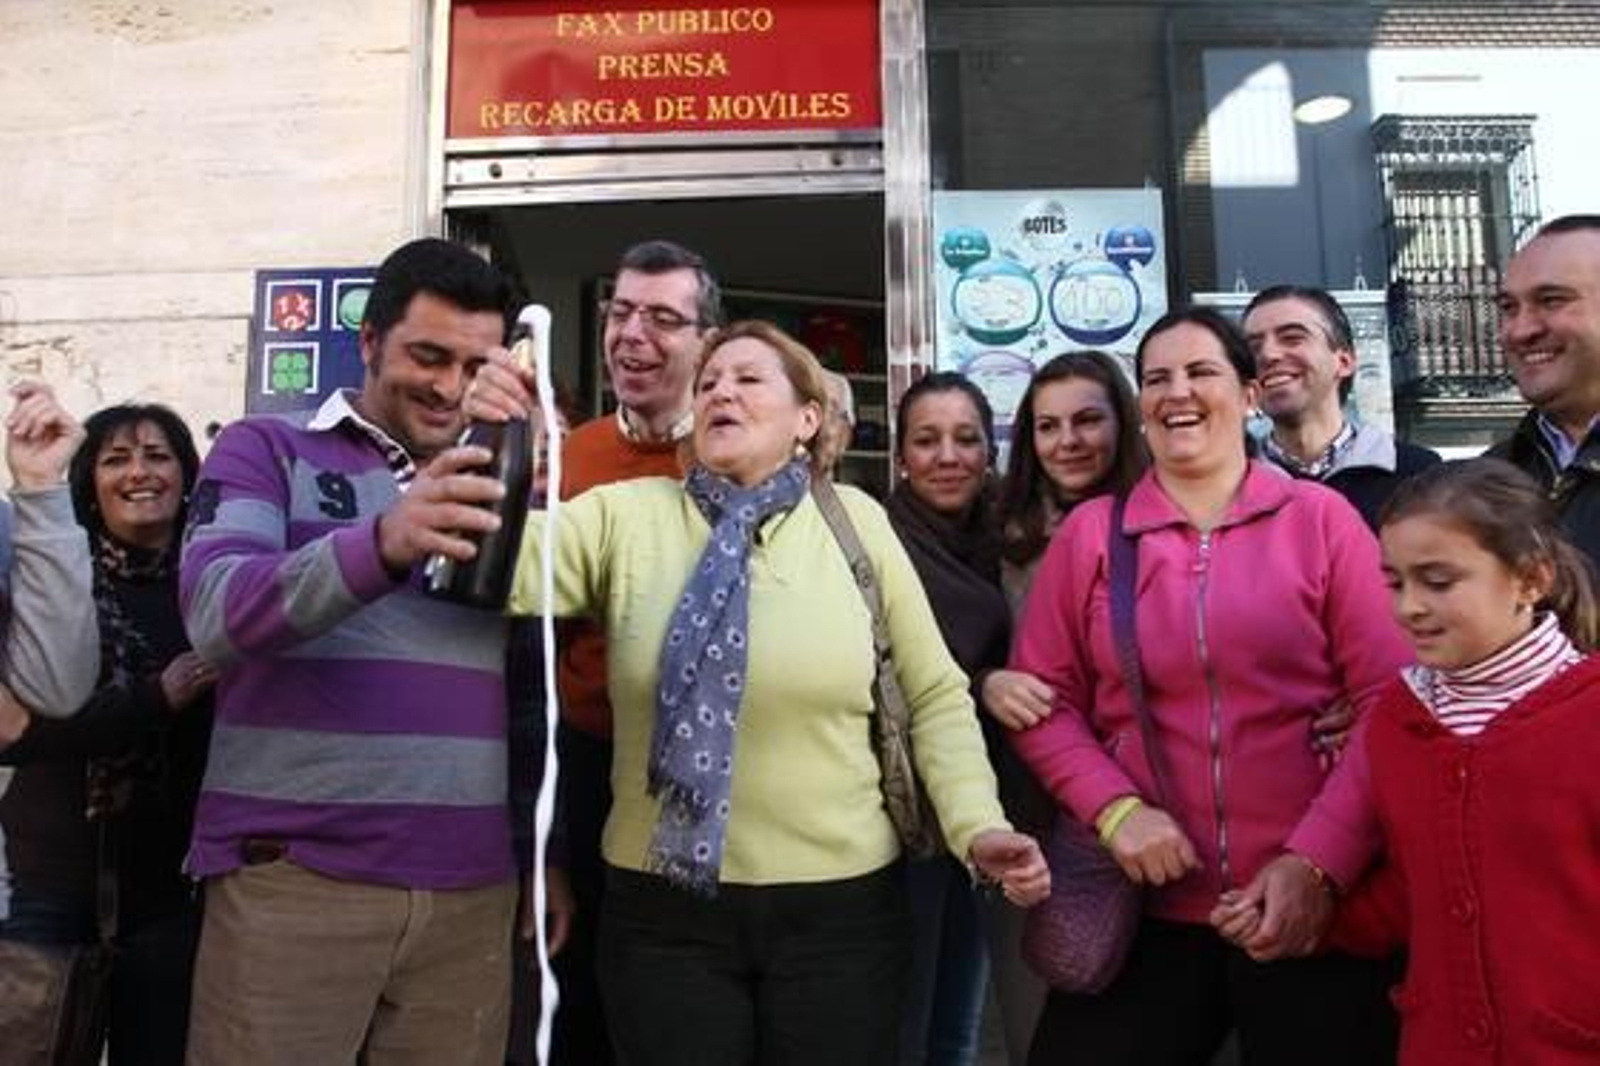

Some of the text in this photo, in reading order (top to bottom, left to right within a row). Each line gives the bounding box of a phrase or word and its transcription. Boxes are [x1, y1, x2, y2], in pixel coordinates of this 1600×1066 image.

[556, 8, 774, 38] FAX PUBLICO
[598, 52, 729, 80] PRENSA
[479, 91, 852, 129] RECARGA DE MOVILES
[316, 470, 358, 520] 9
